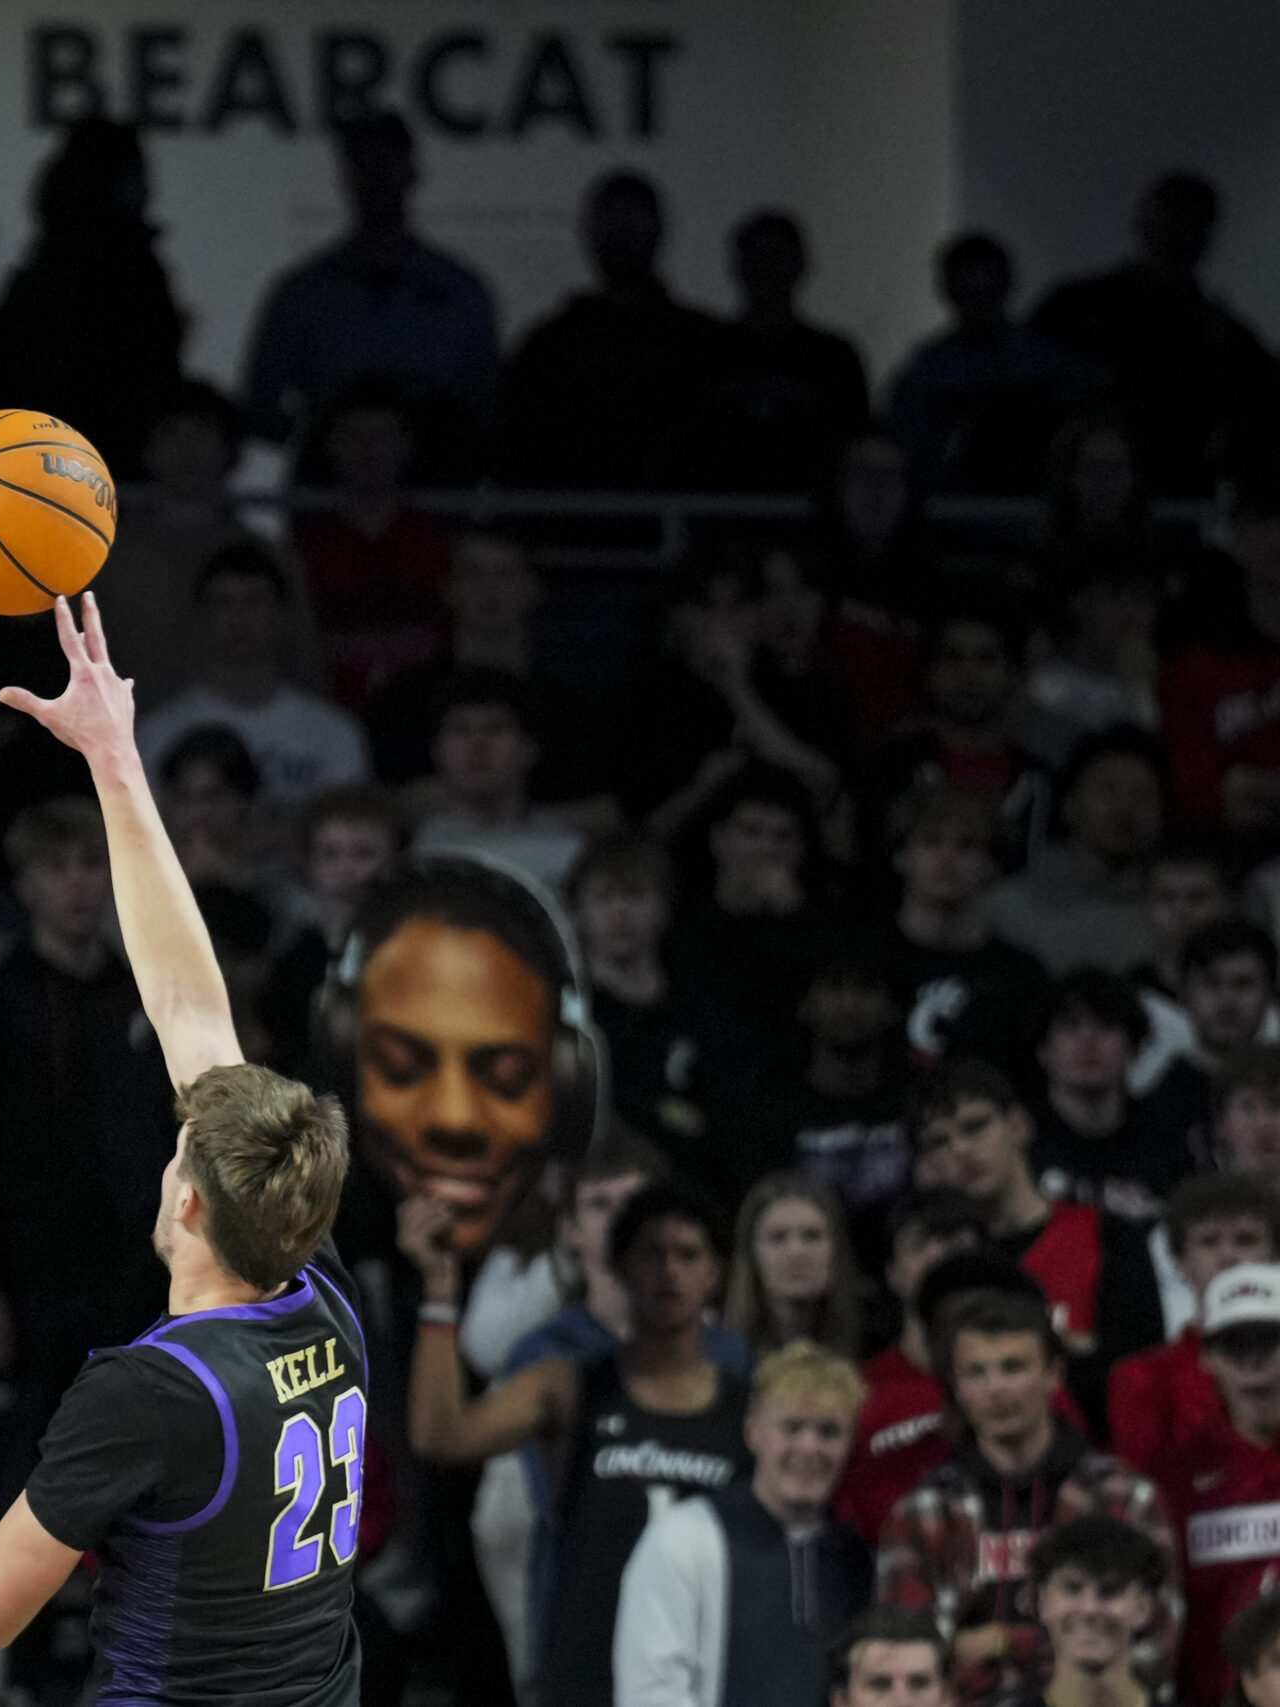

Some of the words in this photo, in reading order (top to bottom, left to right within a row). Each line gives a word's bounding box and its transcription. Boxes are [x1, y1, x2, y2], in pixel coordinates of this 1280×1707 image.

[28, 22, 682, 140] BEARCAT
[266, 1337, 346, 1405] KELL
[263, 1385, 368, 1592] 23
[592, 1438, 737, 1487] CINCINNATI
